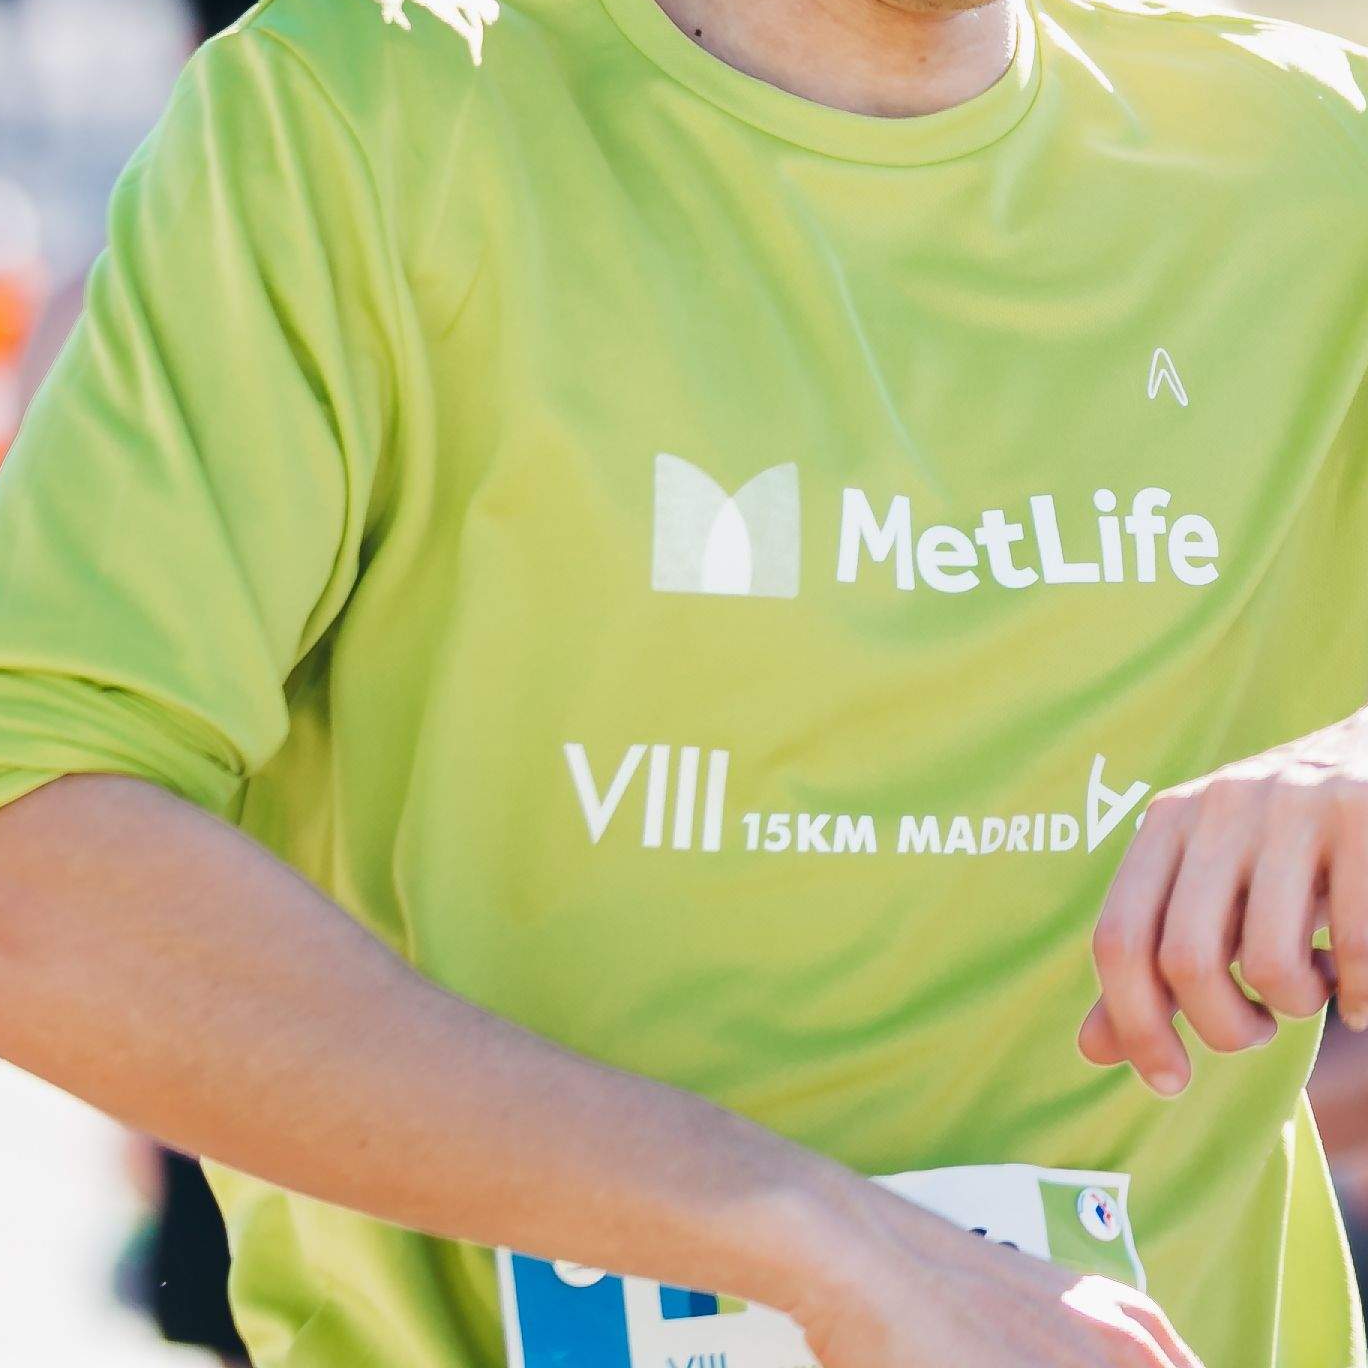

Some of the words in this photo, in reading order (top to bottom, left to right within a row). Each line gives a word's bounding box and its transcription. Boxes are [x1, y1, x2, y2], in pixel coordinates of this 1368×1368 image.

[836, 487, 1220, 593] MetLife
[563, 743, 730, 852] VIII
[742, 812, 878, 854] 15KM
[896, 812, 1080, 855] MADRID
